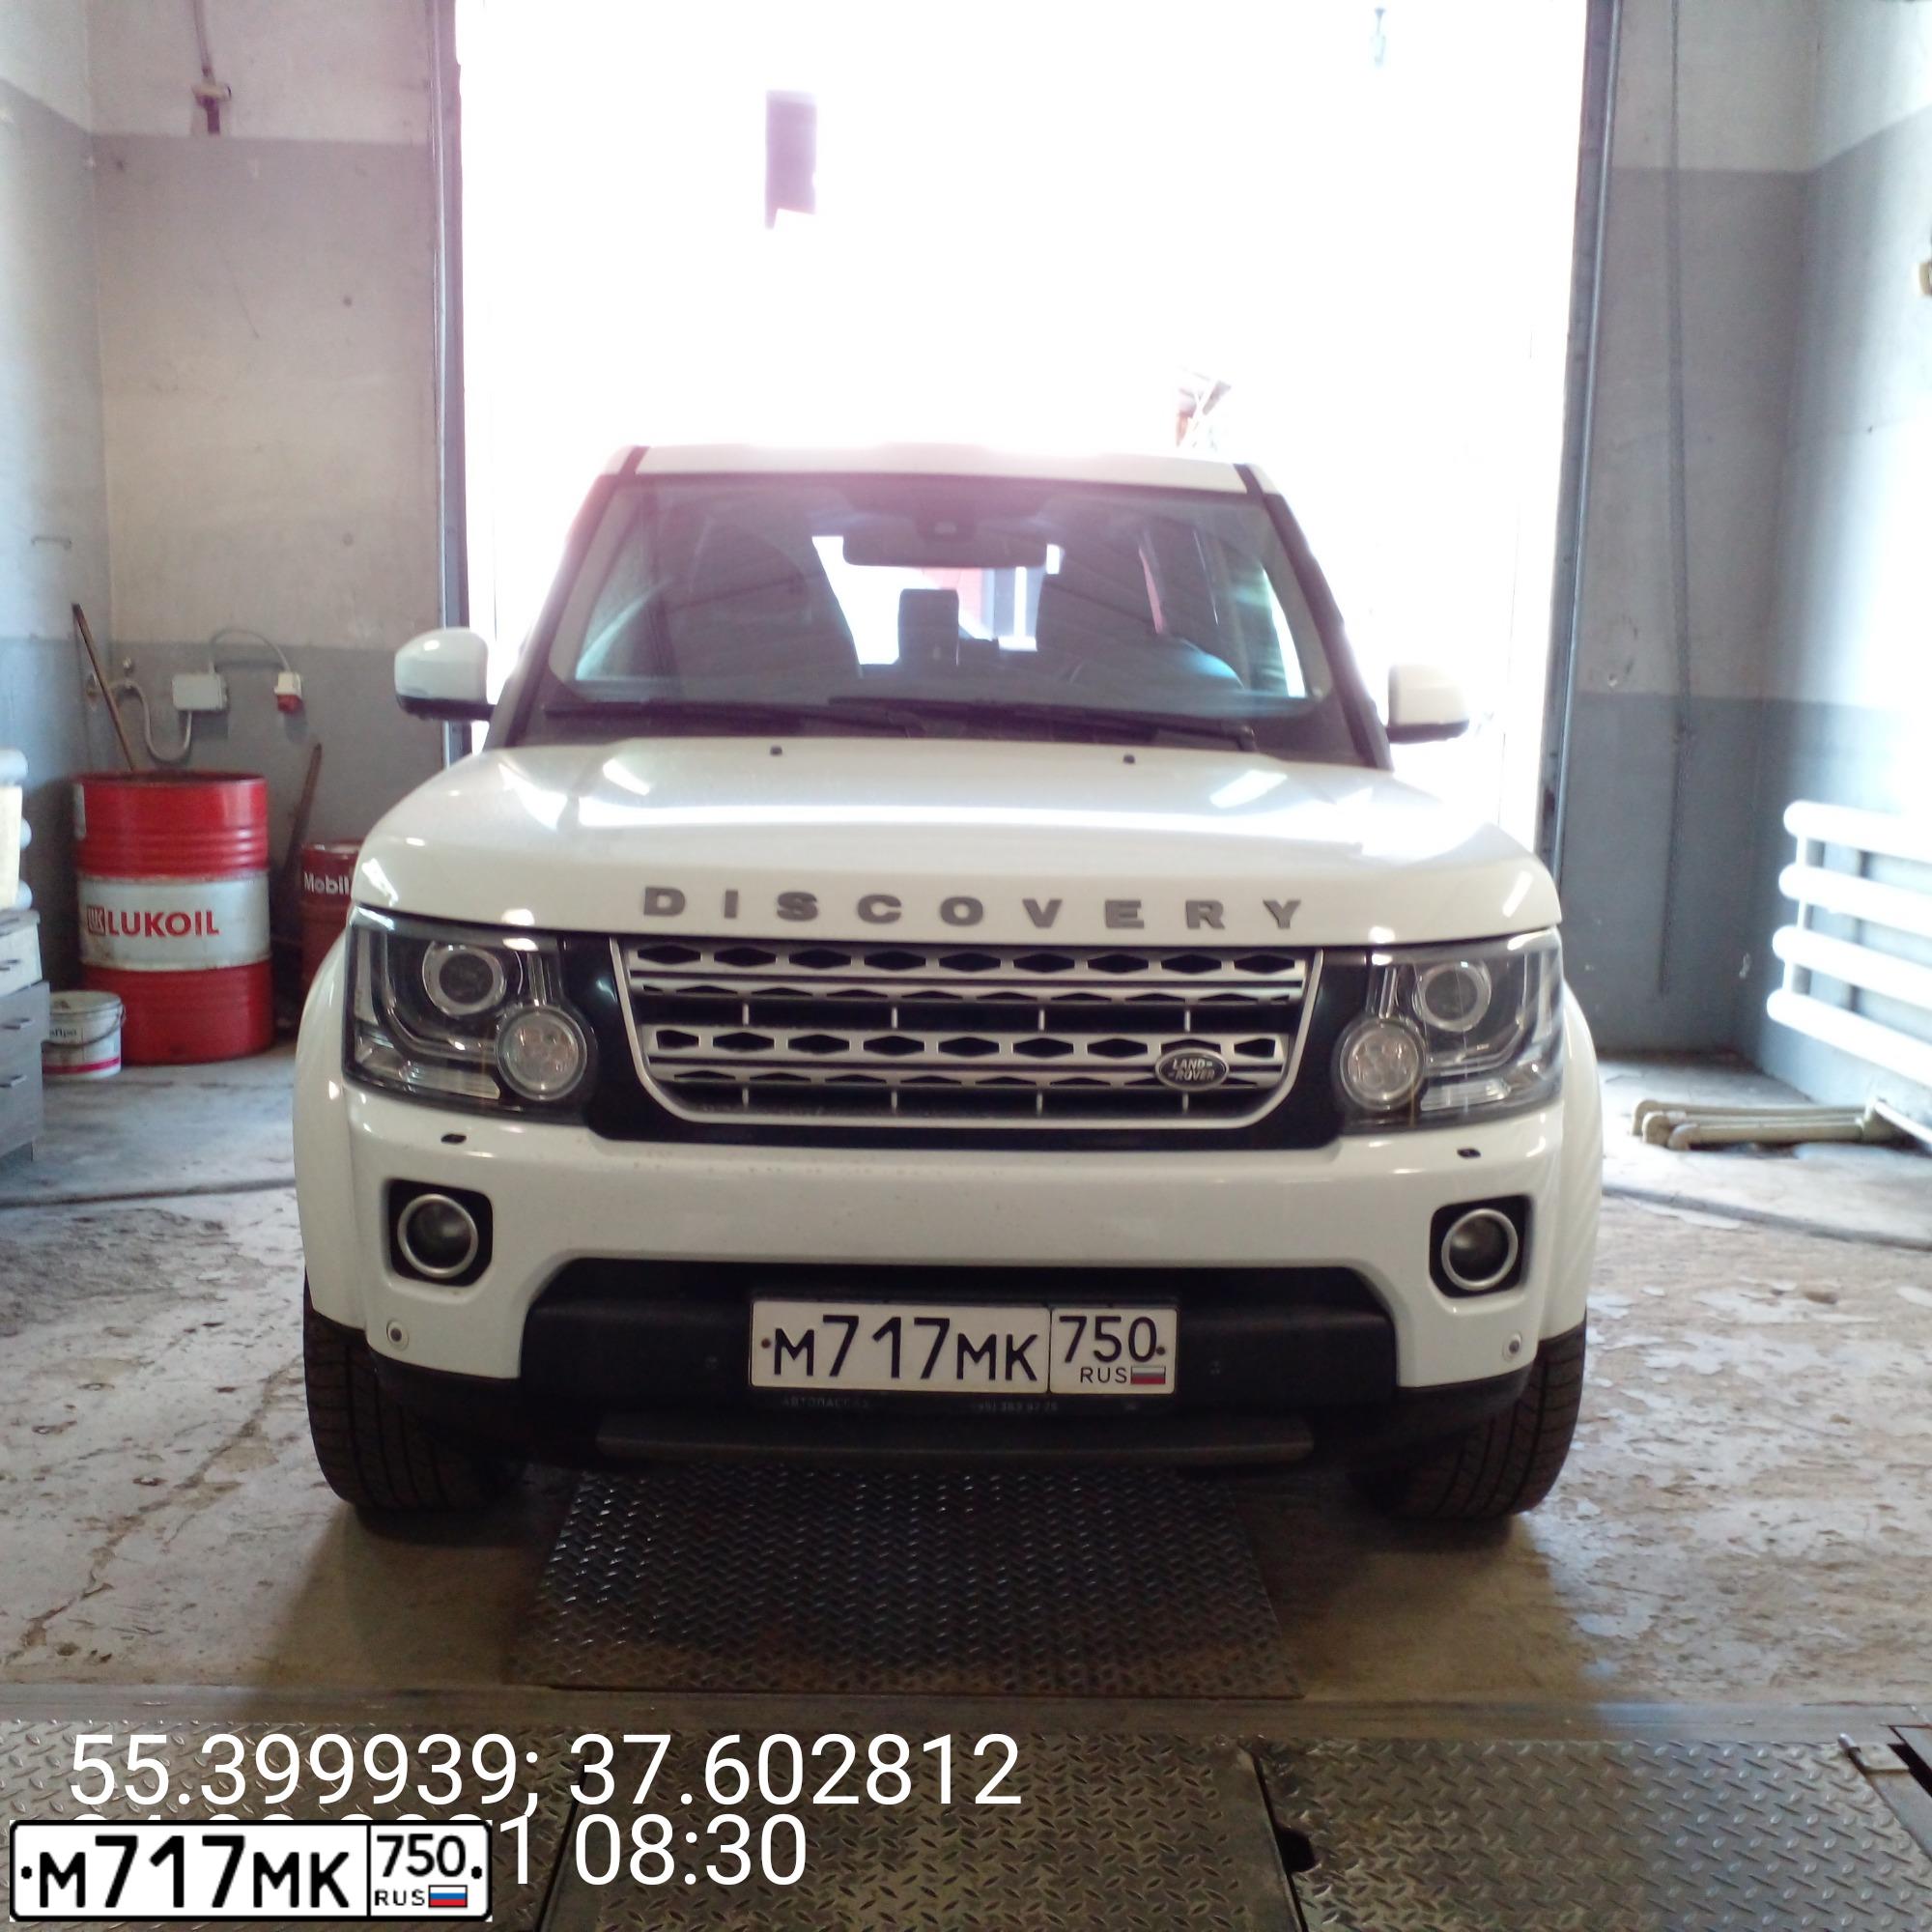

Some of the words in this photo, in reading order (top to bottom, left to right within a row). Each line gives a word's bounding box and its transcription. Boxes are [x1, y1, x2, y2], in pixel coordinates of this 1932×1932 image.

[303, 871, 350, 895] Mobil
[642, 886, 1301, 929] DISCOVERY
[107, 910, 219, 937] LUKOIL
[1173, 1058, 1207, 1070] LAND
[1175, 1067, 1216, 1082] ROVER
[1059, 1315, 1158, 1364] 750
[1079, 1367, 1128, 1385] RUS
